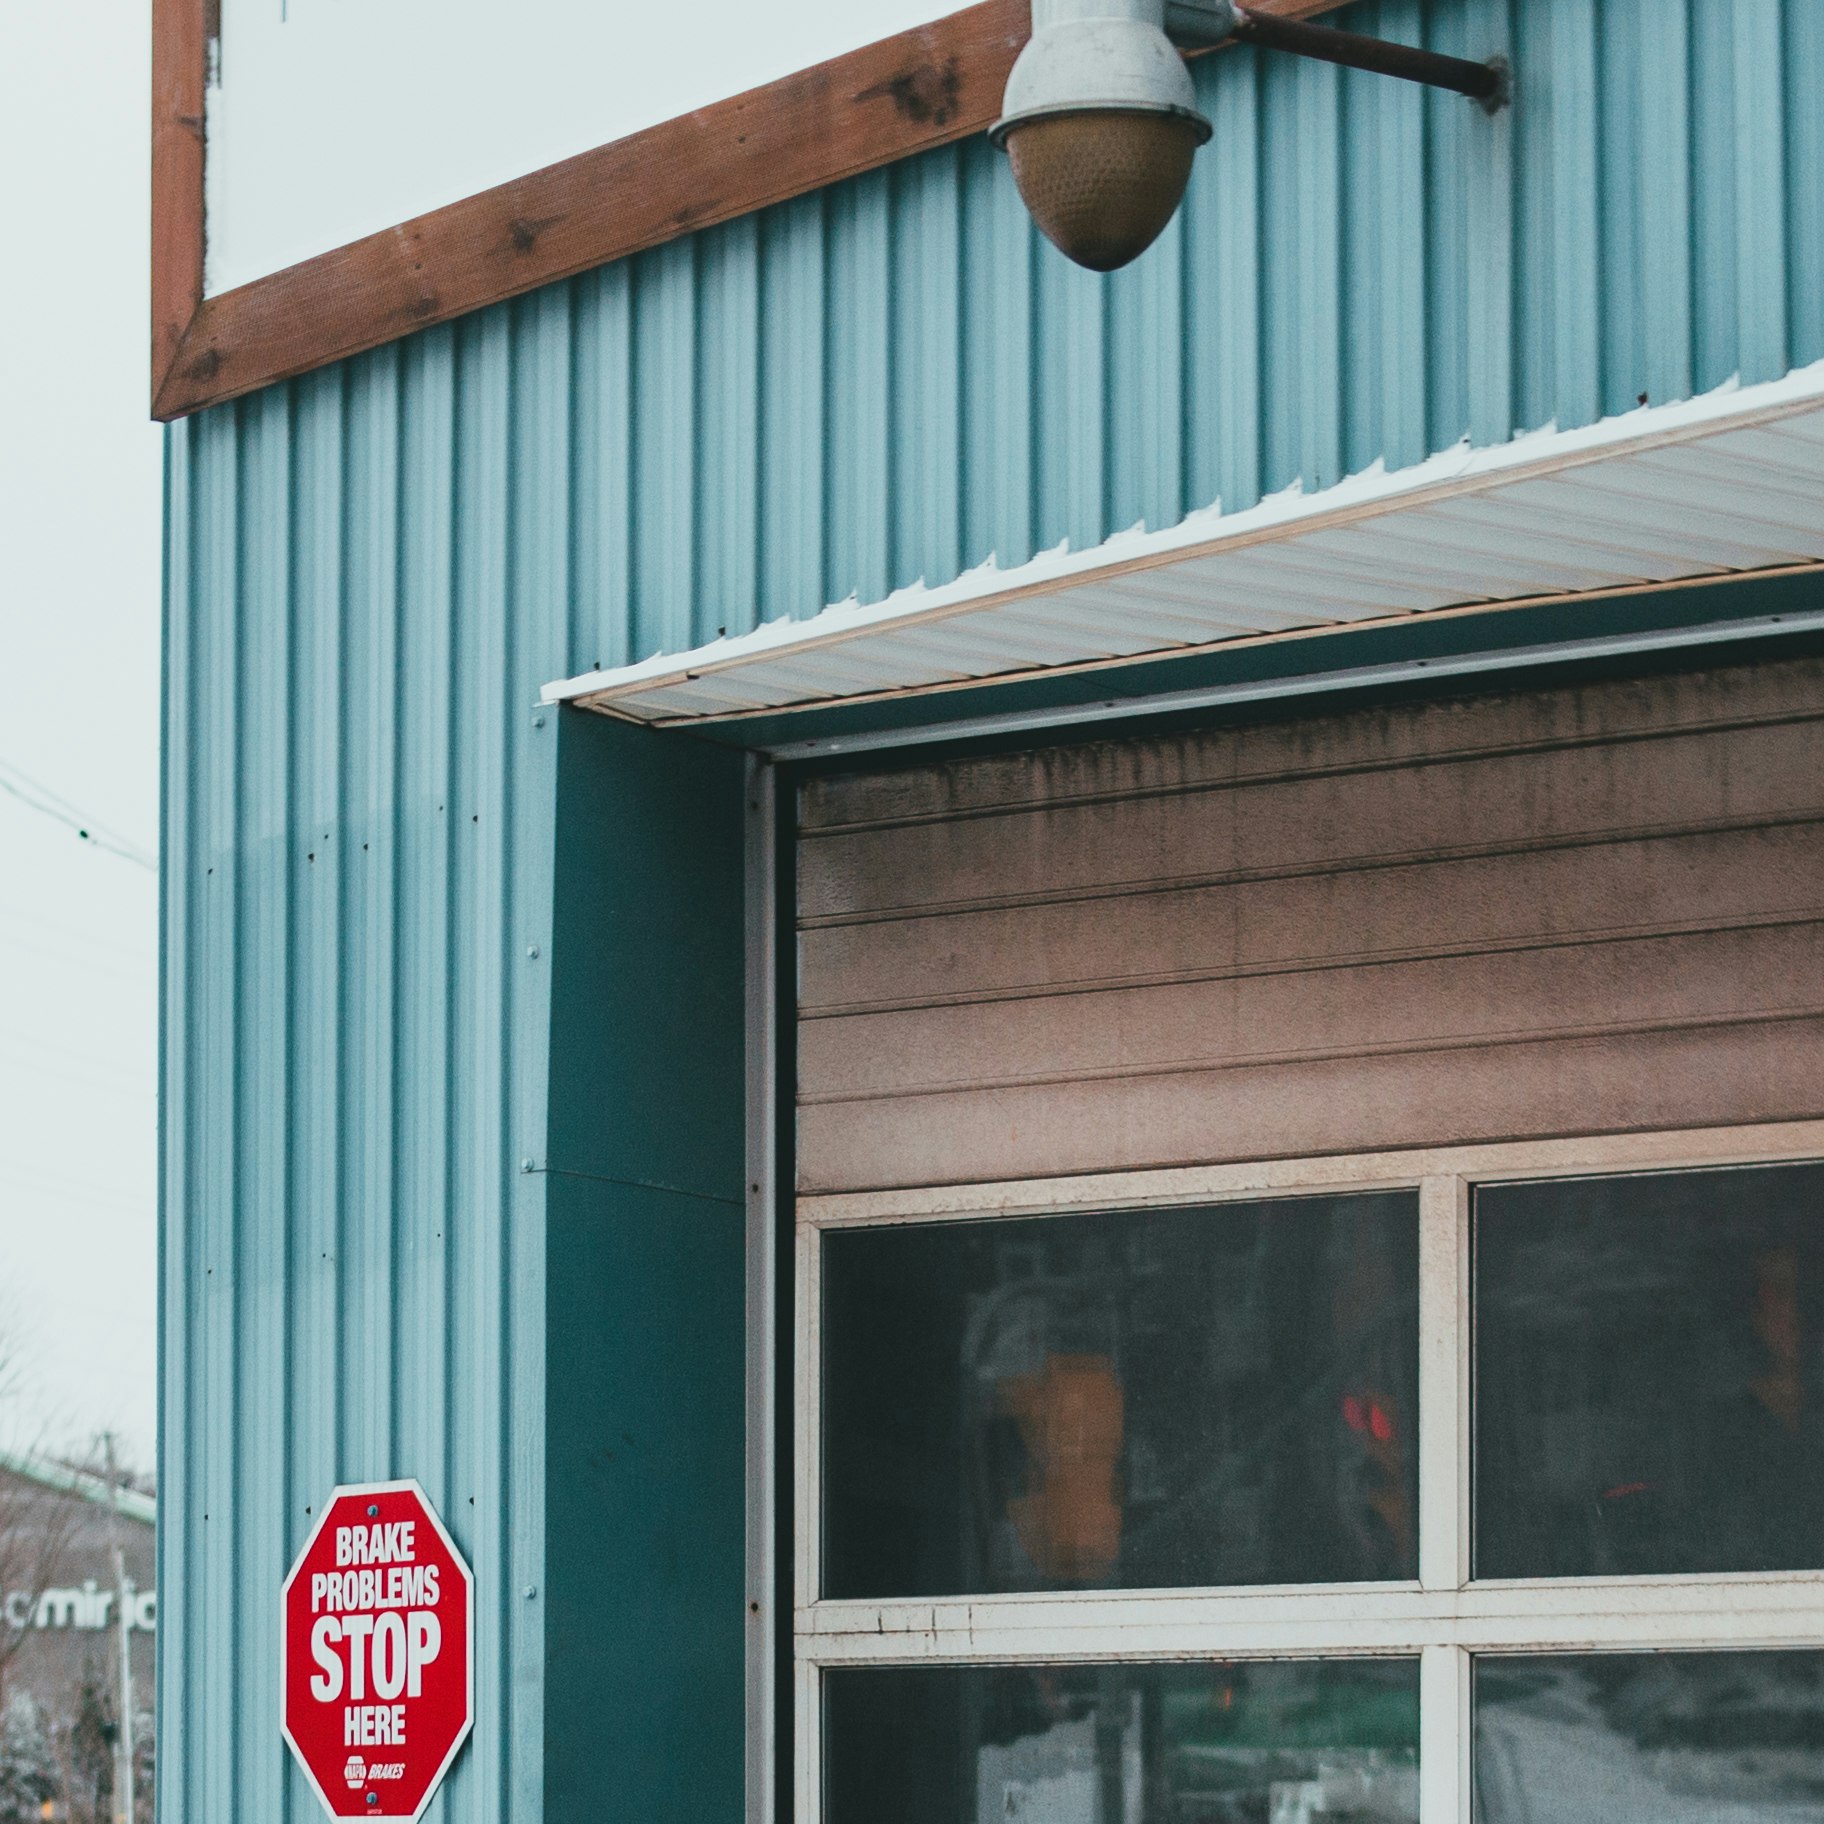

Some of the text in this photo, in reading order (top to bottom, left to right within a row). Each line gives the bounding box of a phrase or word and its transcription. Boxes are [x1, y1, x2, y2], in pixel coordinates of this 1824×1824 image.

[336, 1520, 415, 1567] BRAKE
[311, 1564, 440, 1613] PROBLEMS
[310, 1610, 442, 1703] STOP
[344, 1704, 406, 1747] HERE
[367, 1763, 406, 1780] BRAKES
